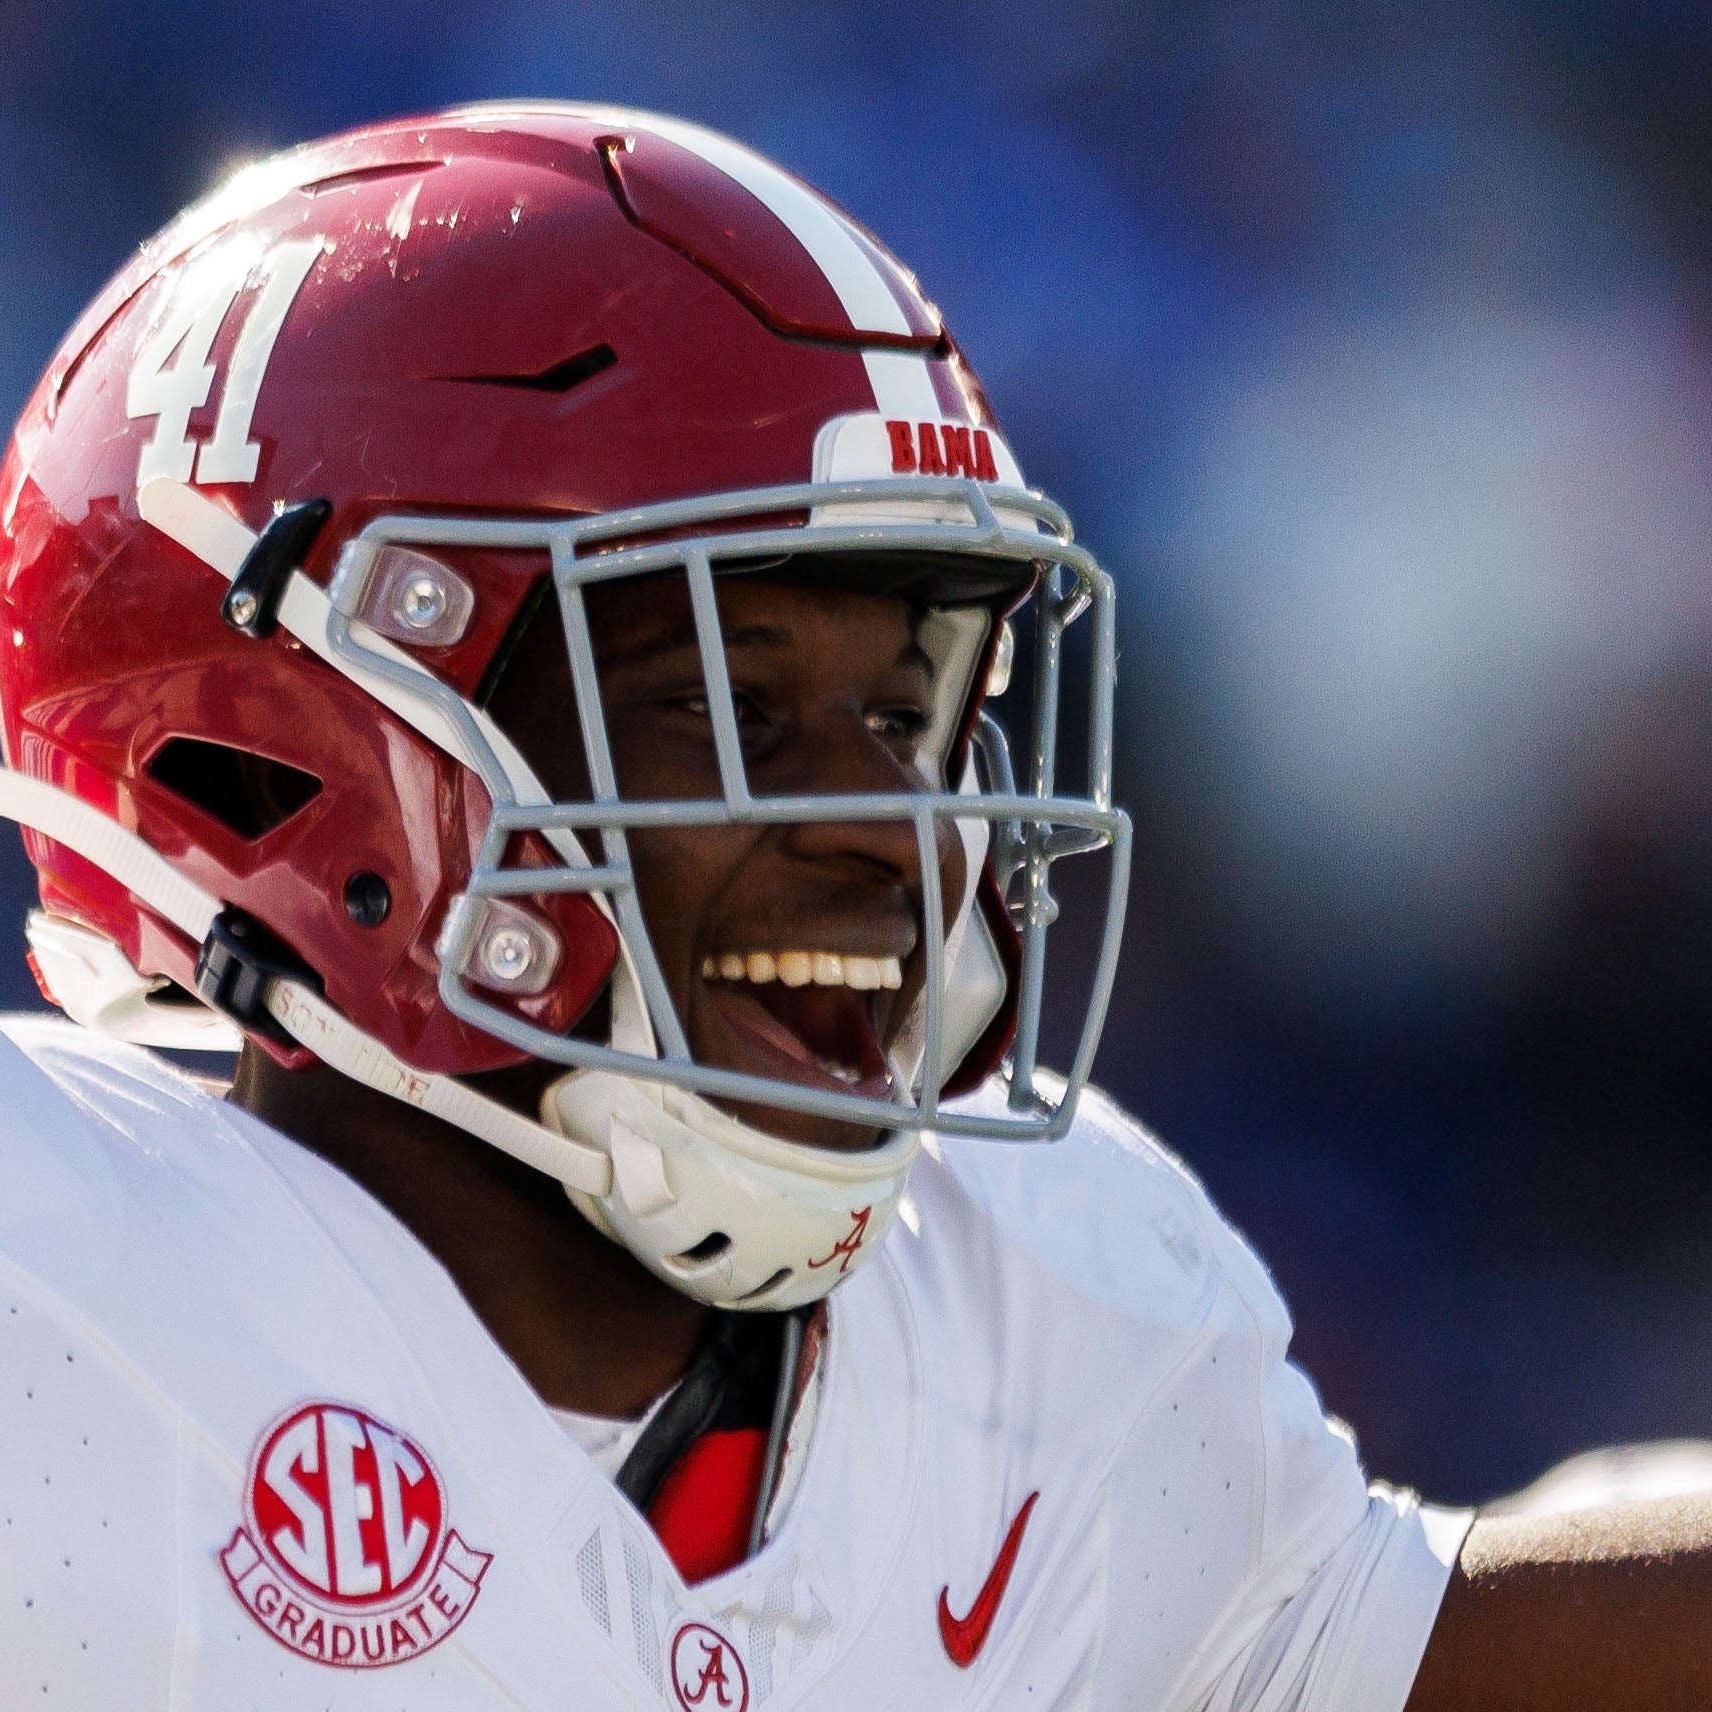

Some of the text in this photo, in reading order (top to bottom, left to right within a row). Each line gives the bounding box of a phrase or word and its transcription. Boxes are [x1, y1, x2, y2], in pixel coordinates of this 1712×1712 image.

[127, 232, 323, 485] 41
[885, 421, 999, 483] BAMA
[807, 1204, 872, 1274] A
[263, 1407, 431, 1598] SEC
[254, 1583, 461, 1661] GRADUATE
[683, 1639, 733, 1708] A
